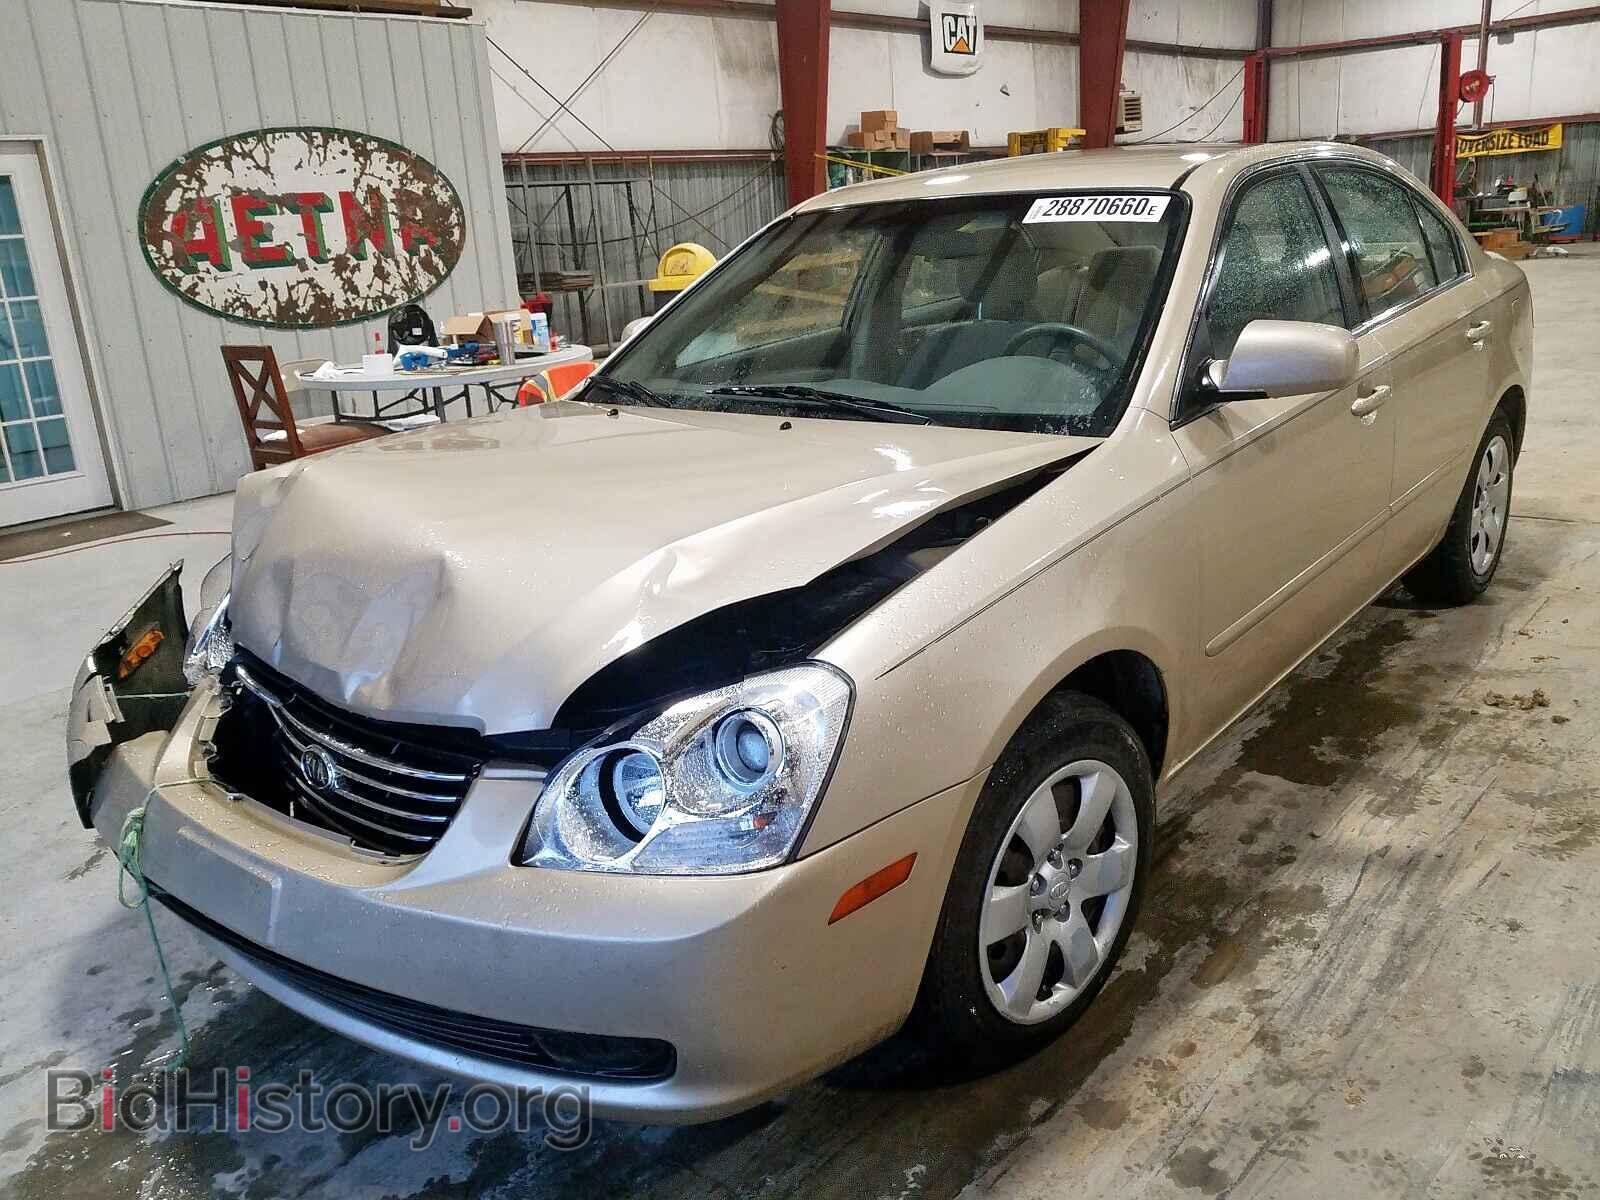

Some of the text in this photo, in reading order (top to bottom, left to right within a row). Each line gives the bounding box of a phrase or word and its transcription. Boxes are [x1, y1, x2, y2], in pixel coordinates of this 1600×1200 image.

[943, 15, 976, 53] CAT
[1459, 130, 1549, 153] OVERSIZE LOAD
